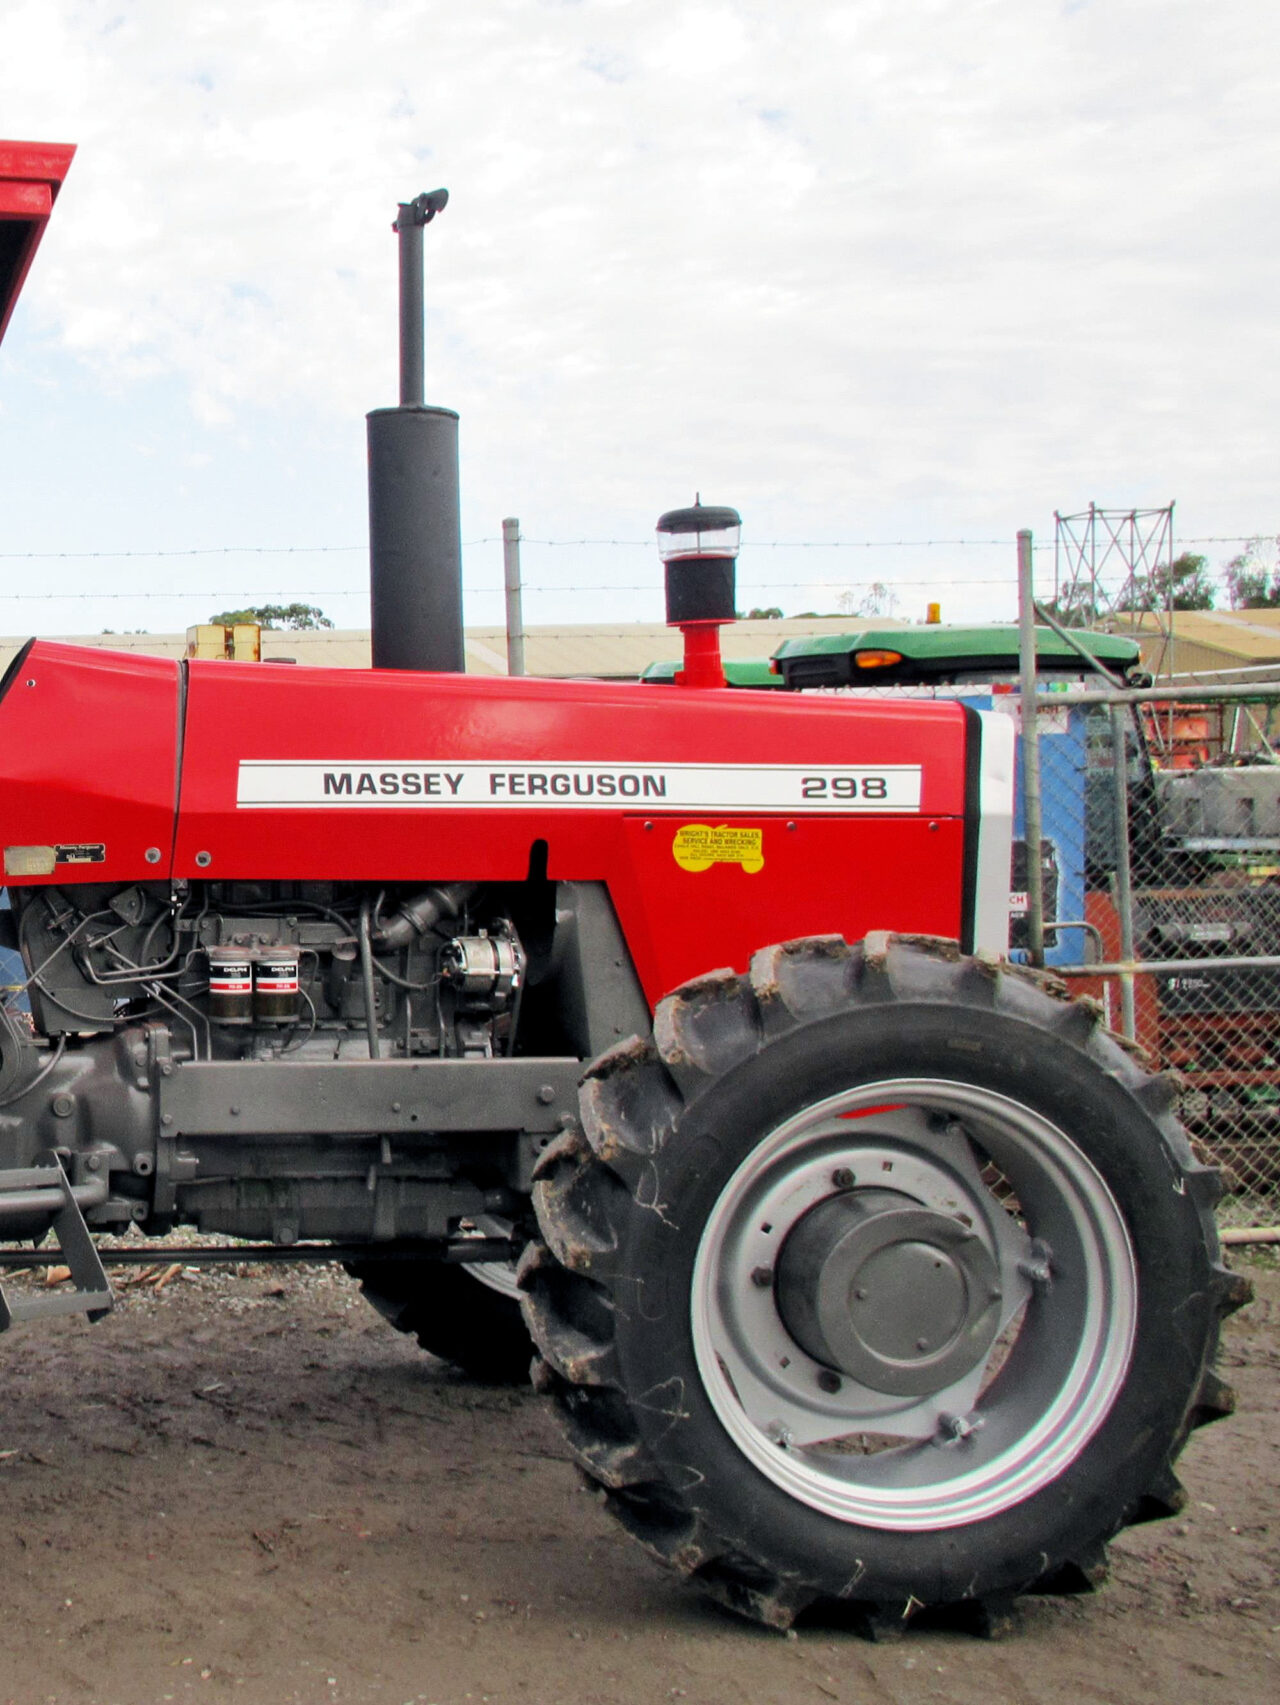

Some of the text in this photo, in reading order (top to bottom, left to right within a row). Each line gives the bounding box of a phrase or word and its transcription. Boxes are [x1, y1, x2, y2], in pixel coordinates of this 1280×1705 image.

[323, 773, 667, 797] MASSEY FERGUSON
[801, 777, 888, 799] 298
[680, 830, 709, 838] WRIGHT'S
